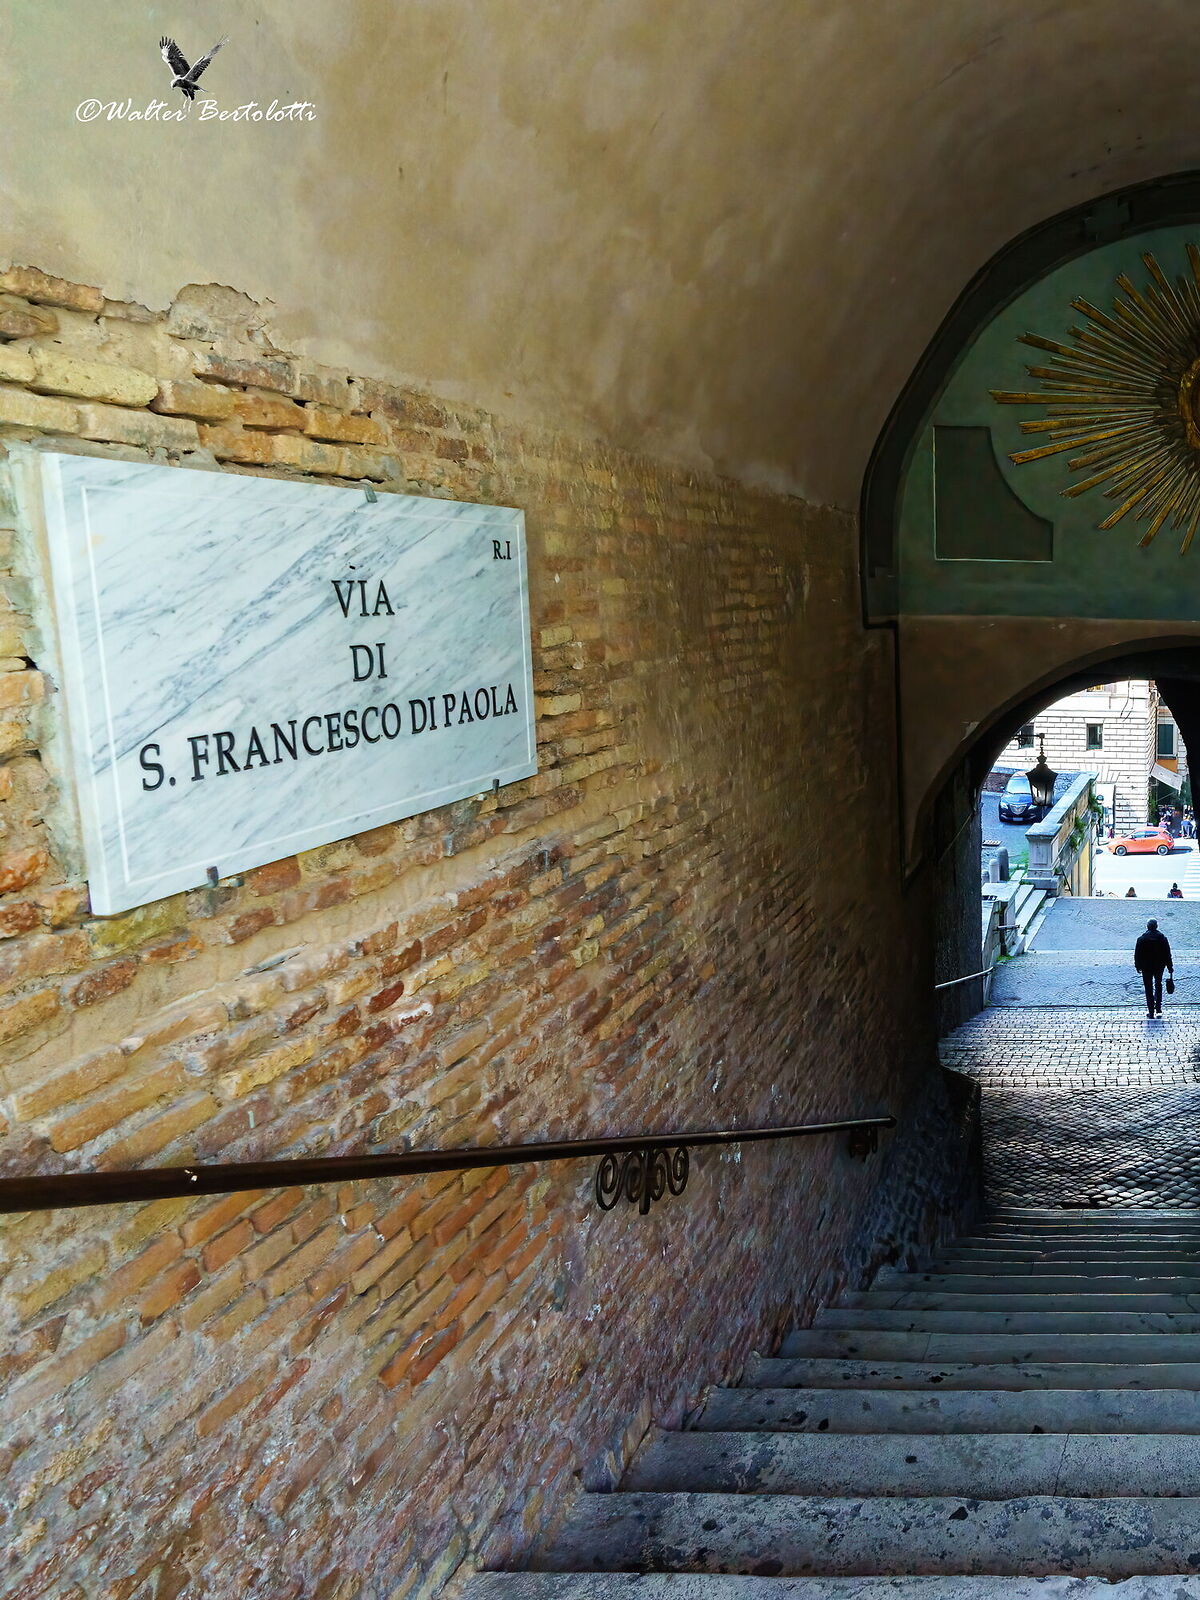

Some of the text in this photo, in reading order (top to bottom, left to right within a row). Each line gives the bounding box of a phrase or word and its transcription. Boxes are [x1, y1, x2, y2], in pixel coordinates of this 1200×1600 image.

[331, 579, 396, 619] VIA
[349, 642, 388, 683] DI
[139, 682, 519, 792] S. FRANCESCO DI PAOLA
